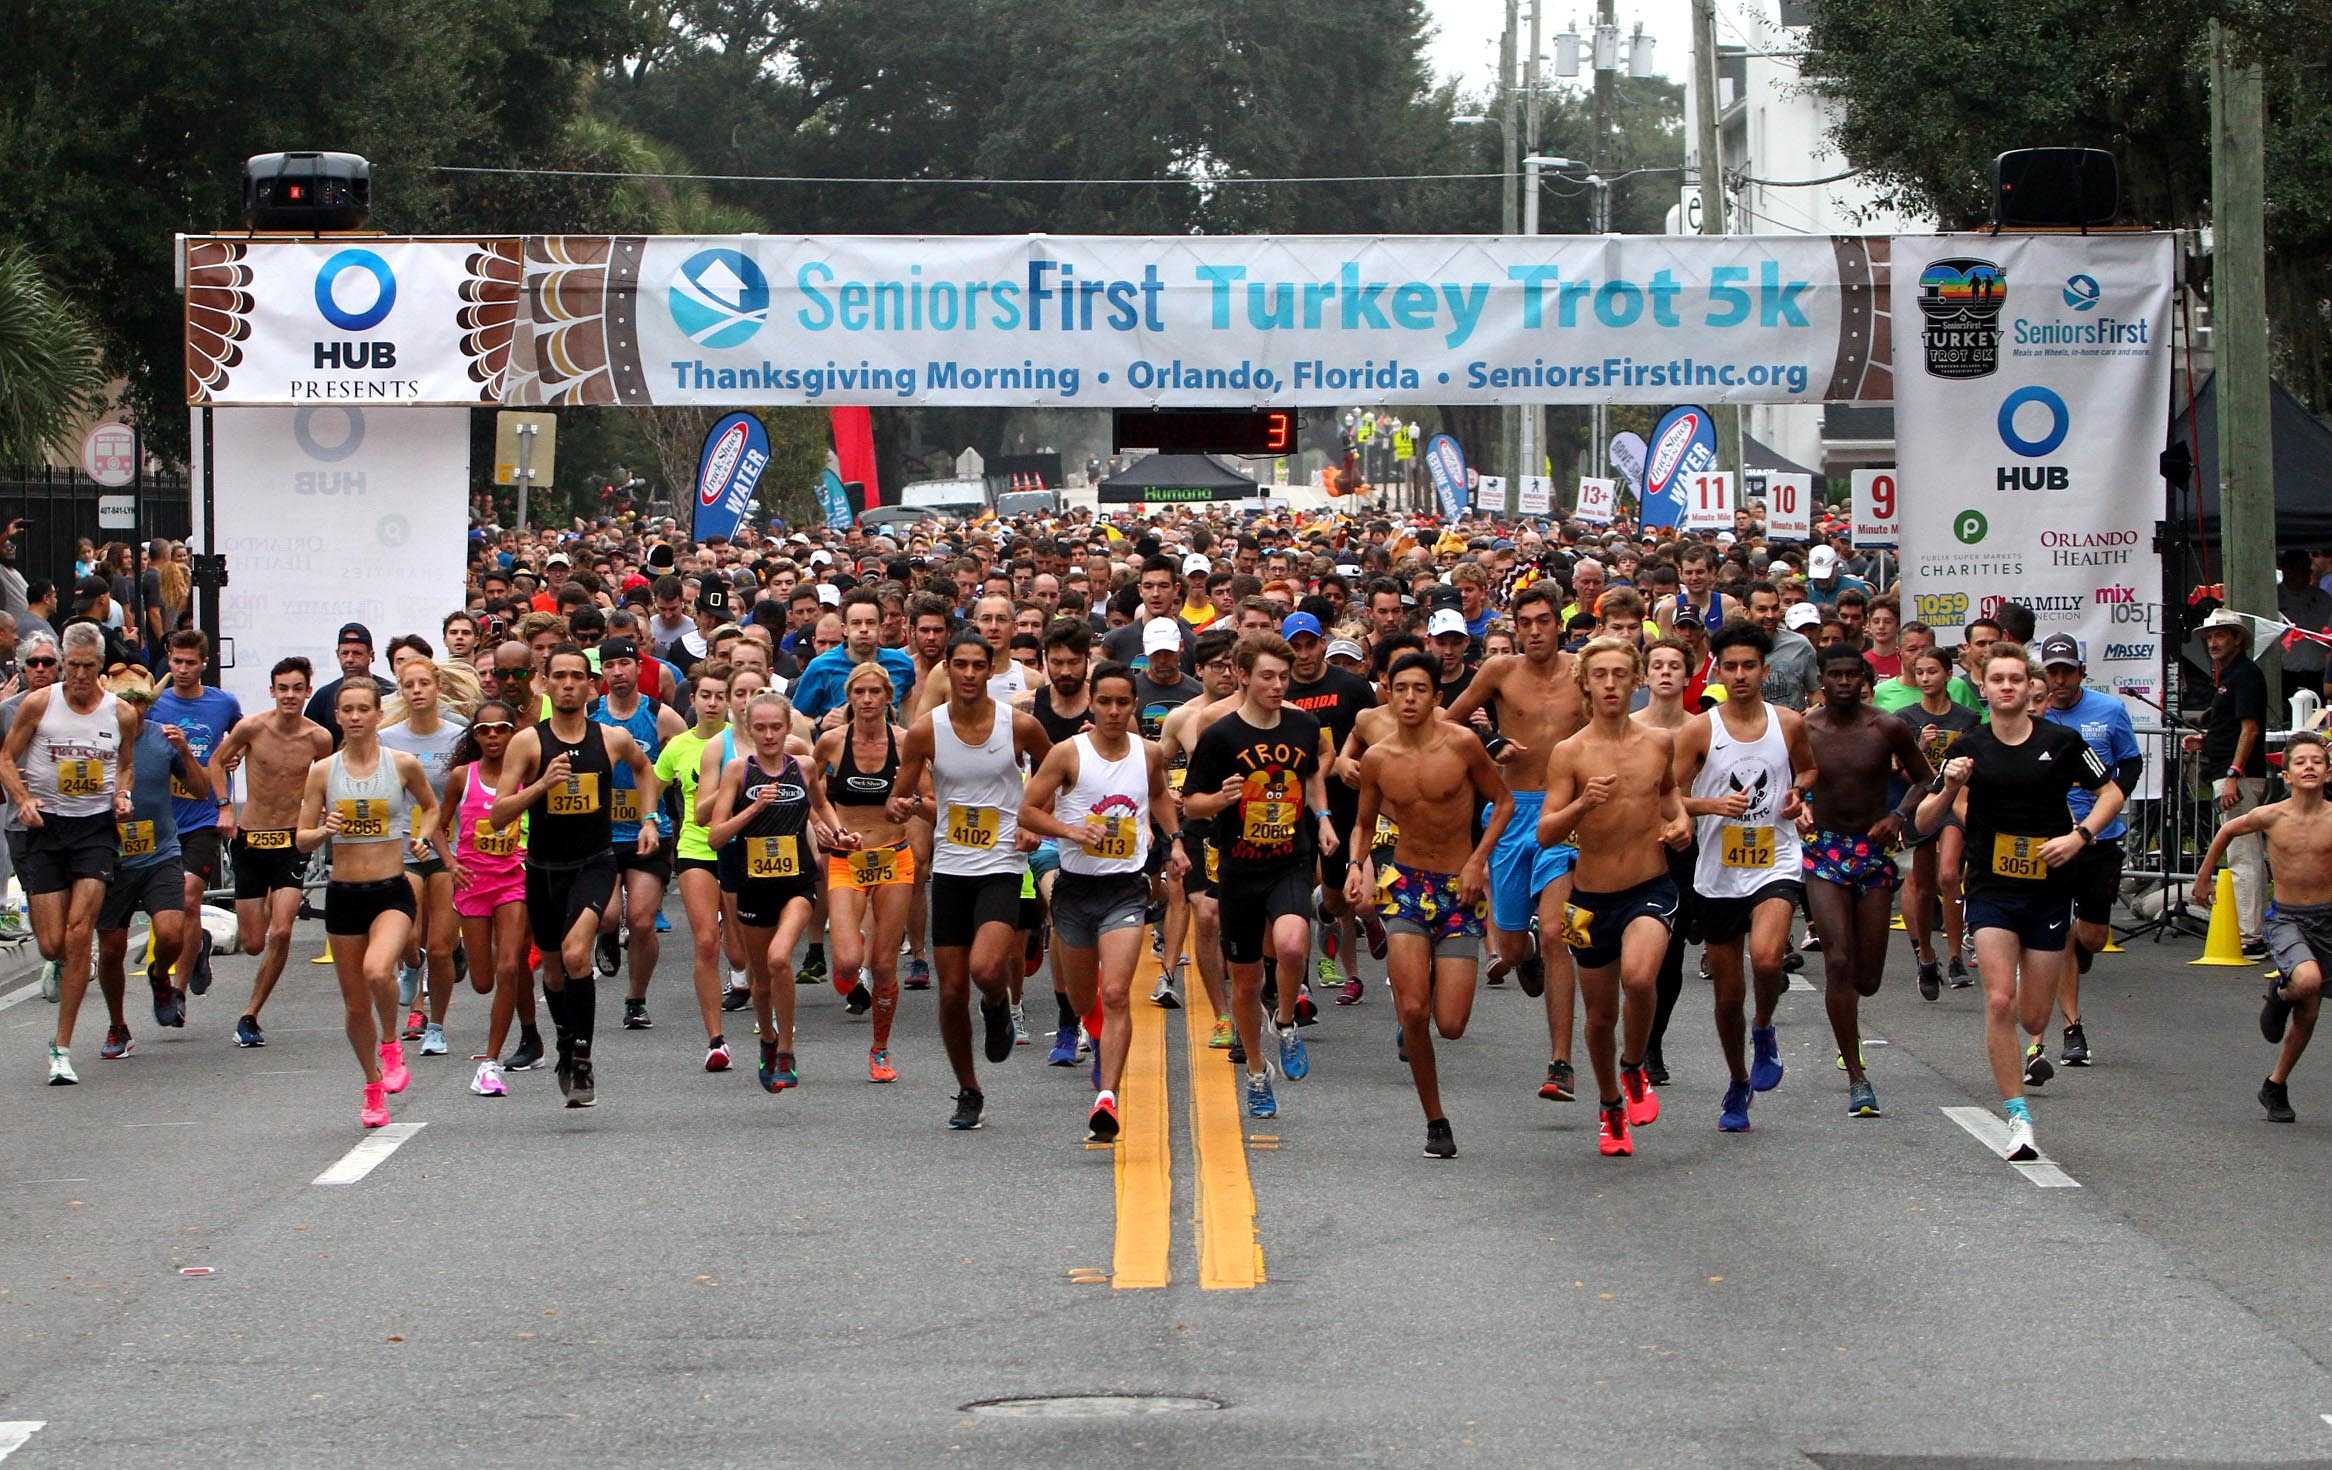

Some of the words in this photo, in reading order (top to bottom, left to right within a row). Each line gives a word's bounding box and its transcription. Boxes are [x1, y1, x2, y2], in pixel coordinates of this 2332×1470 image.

[797, 259, 1165, 333] SeniorsFirst
[1195, 260, 1491, 350] Turkey
[1508, 262, 1682, 331] Trot
[1705, 259, 1810, 329] 5k
[1921, 331, 2004, 348] TURKEY
[2014, 317, 2148, 345] SeniorsFirst
[313, 341, 397, 369] HUB
[1930, 349, 1968, 362] TROT
[1973, 349, 1994, 362] 5K
[670, 359, 917, 399] Thanksgiving
[926, 360, 1081, 397] Morning
[1126, 359, 1284, 395] Orlando,
[1293, 358, 1420, 391] Florida
[1467, 357, 1809, 394] SeniorsFirstInc.org
[289, 380, 419, 399] PRESENTS
[1267, 414, 1287, 448] 3
[717, 428, 741, 461] Shack
[724, 447, 767, 516] WATER
[1996, 466, 2070, 492] HUB
[1143, 486, 1213, 501] Humana
[1582, 484, 1609, 506] 13+
[1695, 476, 1725, 509] 11
[1772, 485, 1796, 514] 10
[1871, 475, 1895, 520] 9
[1692, 513, 1715, 521] Minute
[1717, 513, 1731, 521] Mile
[1771, 520, 1793, 531] Minute
[1794, 520, 1808, 531] Mile
[1857, 523, 1888, 535] Minute
[2040, 530, 2138, 548] ORLANDO
[1953, 553, 1979, 561] SUPER
[1982, 552, 2023, 560] MARKETS
[2053, 549, 2128, 567] HEALTH
[1920, 562, 2023, 577] CHARITIES
[2096, 583, 2135, 604] mix
[1914, 591, 1969, 616] 1059
[2012, 596, 2084, 611] FAMILY
[2103, 643, 2155, 659] MASSEY
[1294, 693, 1338, 711] ORIDA
[1236, 743, 1307, 770] TROT
[63, 779, 98, 793] 2445
[554, 794, 591, 811] 3751
[1753, 806, 1770, 821] FTC
[343, 819, 382, 835] 2865
[952, 826, 991, 846] 4102
[124, 838, 149, 853] 637
[252, 830, 286, 846] 2553
[479, 836, 515, 851] 3118
[1093, 838, 1126, 856] 413
[1727, 847, 1769, 865] 4112
[754, 857, 793, 875] 3449
[856, 865, 893, 884] 3875
[1999, 856, 2039, 876] 3051
